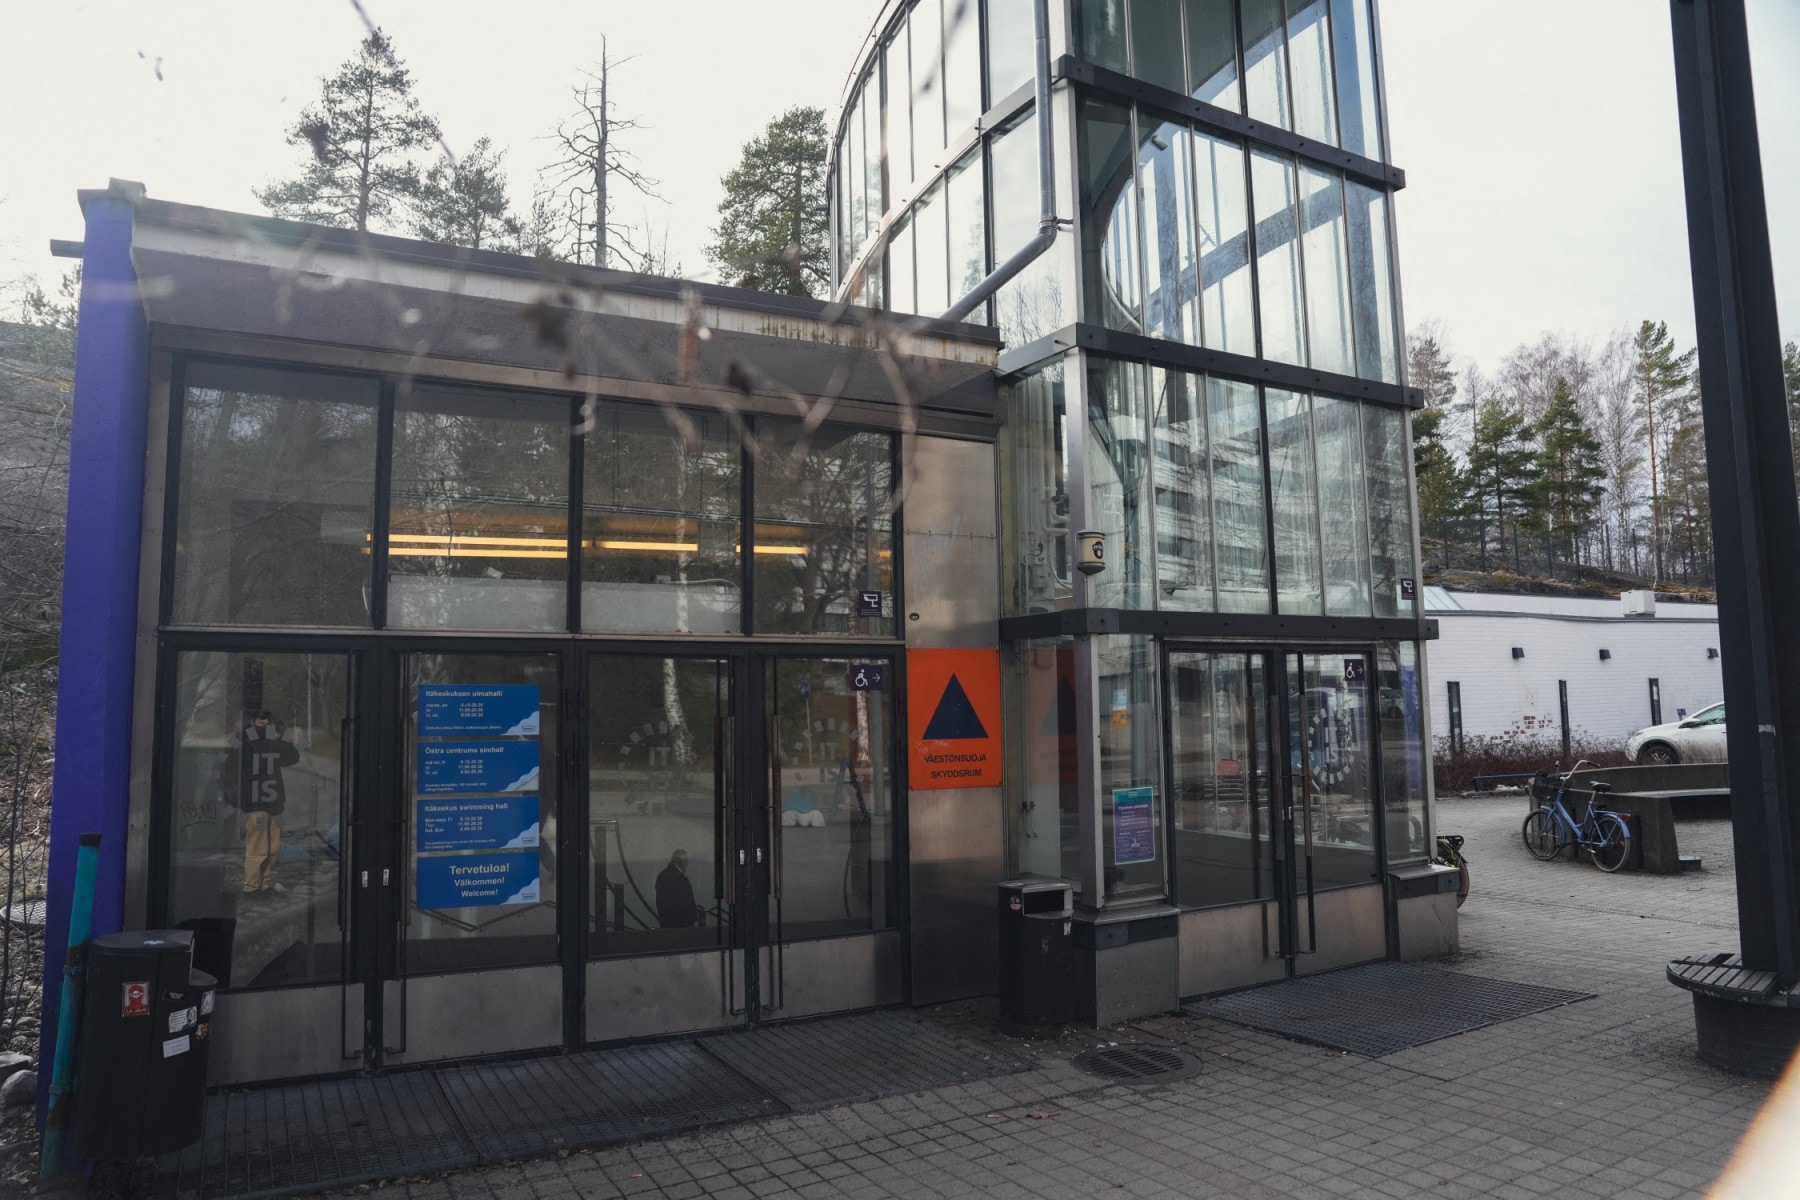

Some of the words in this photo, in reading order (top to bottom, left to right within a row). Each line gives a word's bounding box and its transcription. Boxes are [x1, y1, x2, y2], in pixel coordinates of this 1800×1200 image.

[445, 746, 479, 754] centrums
[925, 753, 987, 763] VÄESTÖNSUOJA
[252, 752, 281, 776] IT
[931, 769, 982, 779] SKYDDSRUM
[251, 780, 278, 803] IS
[459, 803, 494, 811] swimming
[449, 863, 510, 875] Tervetuloa!
[454, 877, 505, 887] Välkommen!
[460, 889, 498, 897] Welcome!
